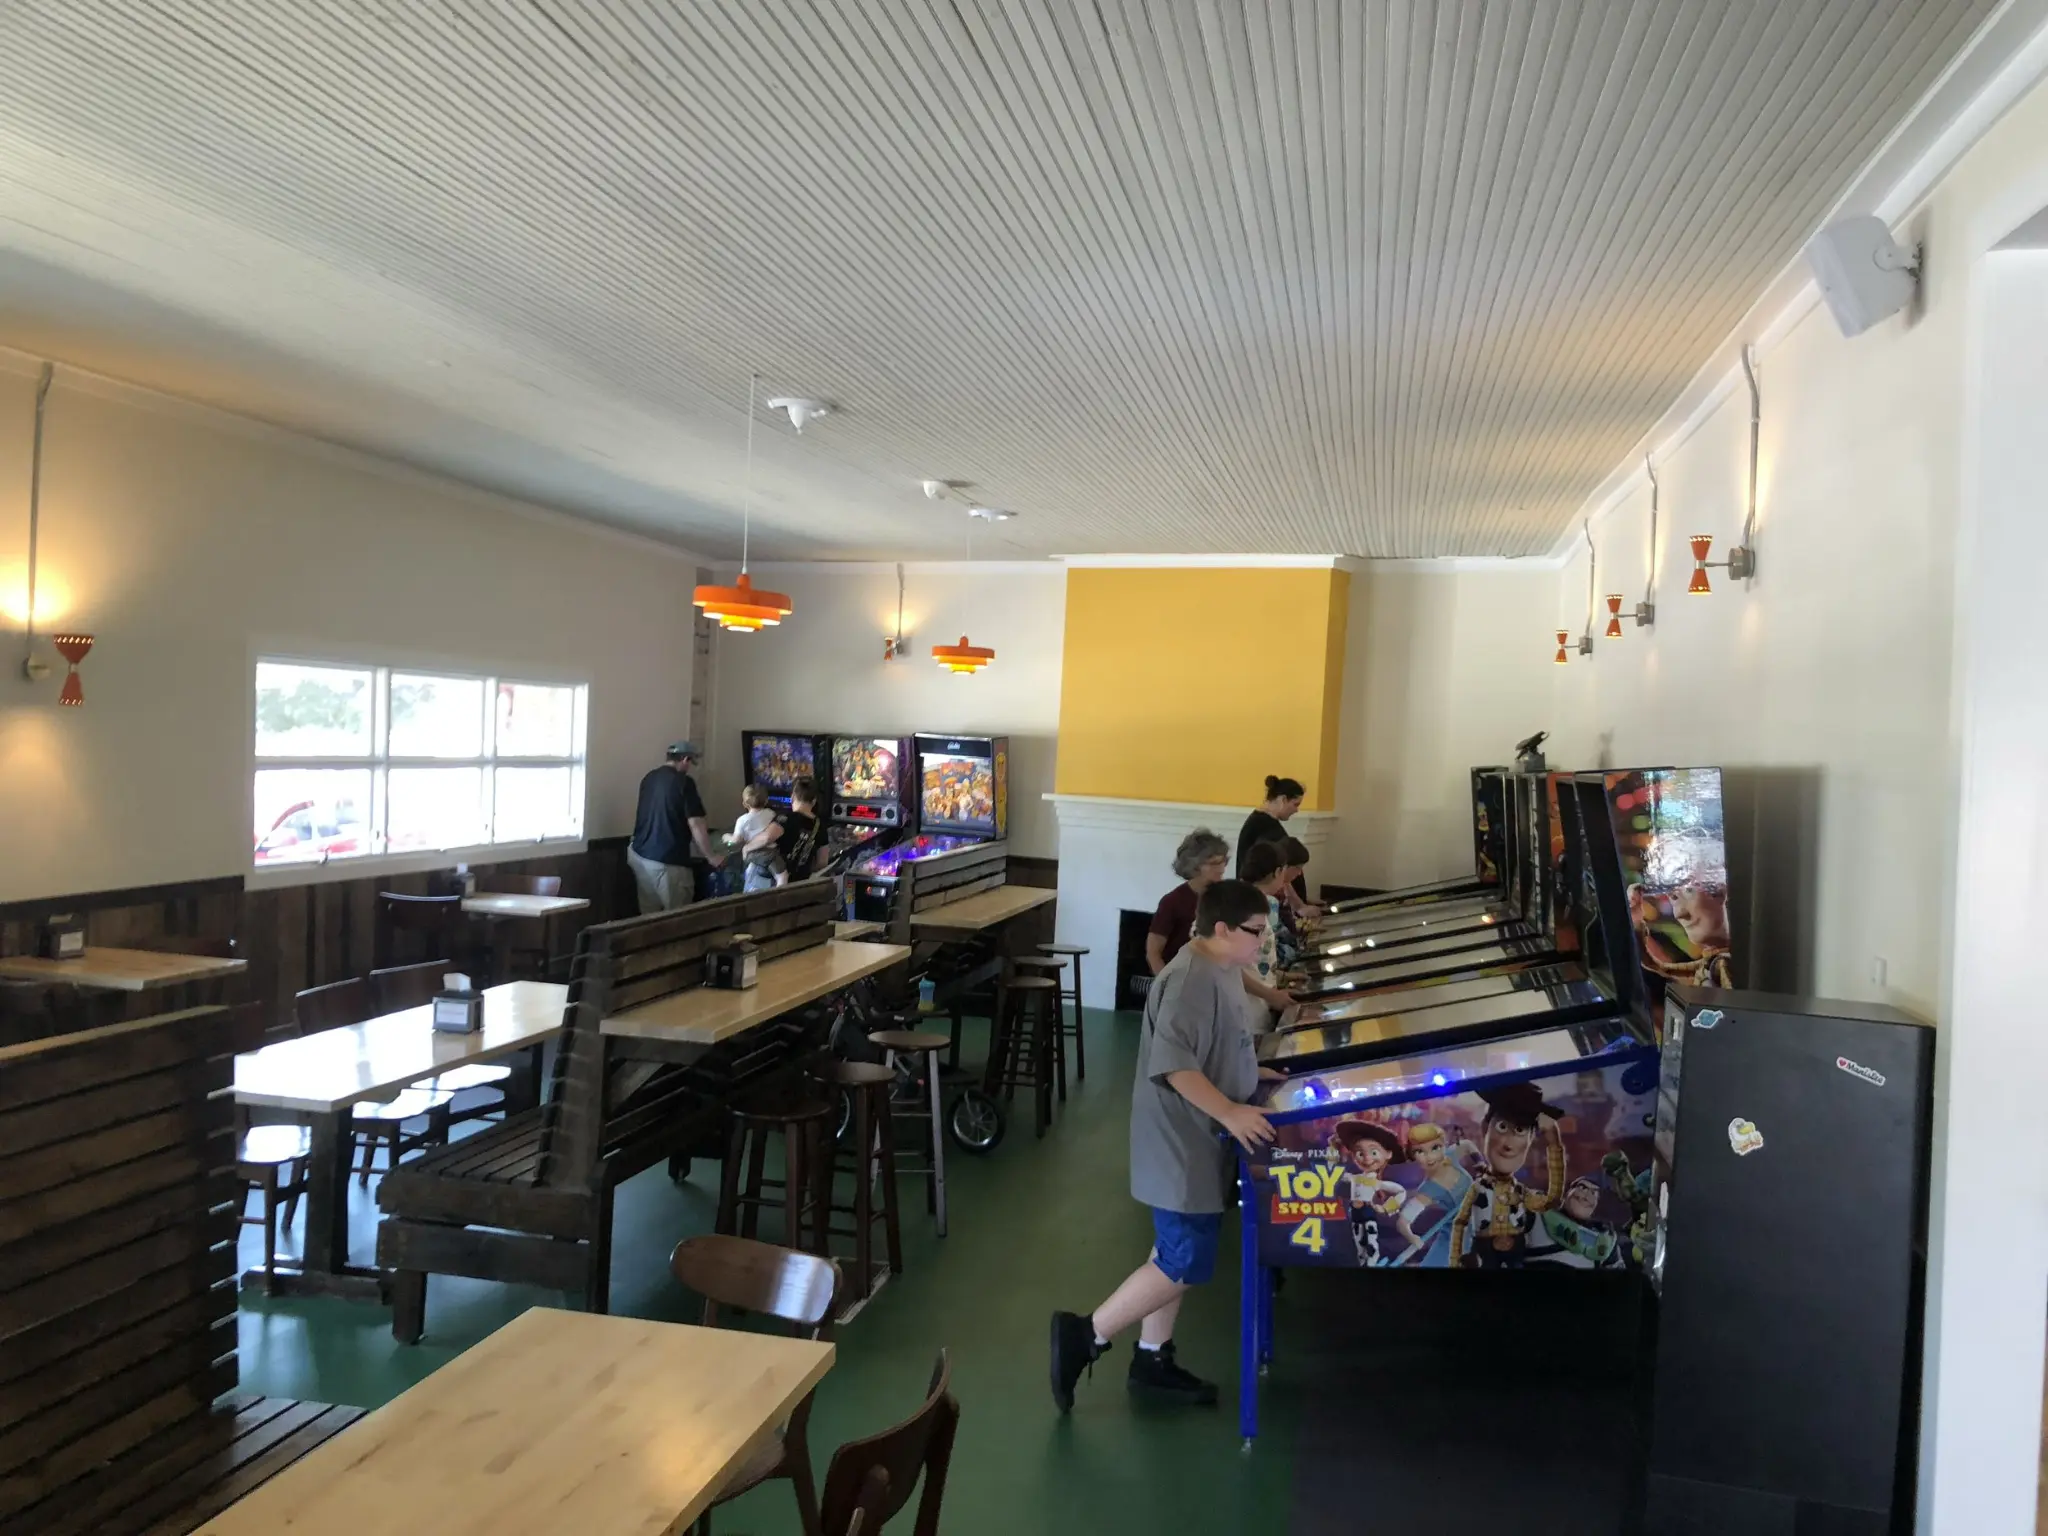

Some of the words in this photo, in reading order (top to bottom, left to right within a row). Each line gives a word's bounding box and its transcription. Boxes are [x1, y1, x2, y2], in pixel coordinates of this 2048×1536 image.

[1271, 1147, 1303, 1160] Disney
[1308, 1149, 1340, 1159] PIXAR
[1269, 1164, 1345, 1199] TOY
[1278, 1202, 1338, 1214] STORY
[1292, 1217, 1326, 1253] 4
